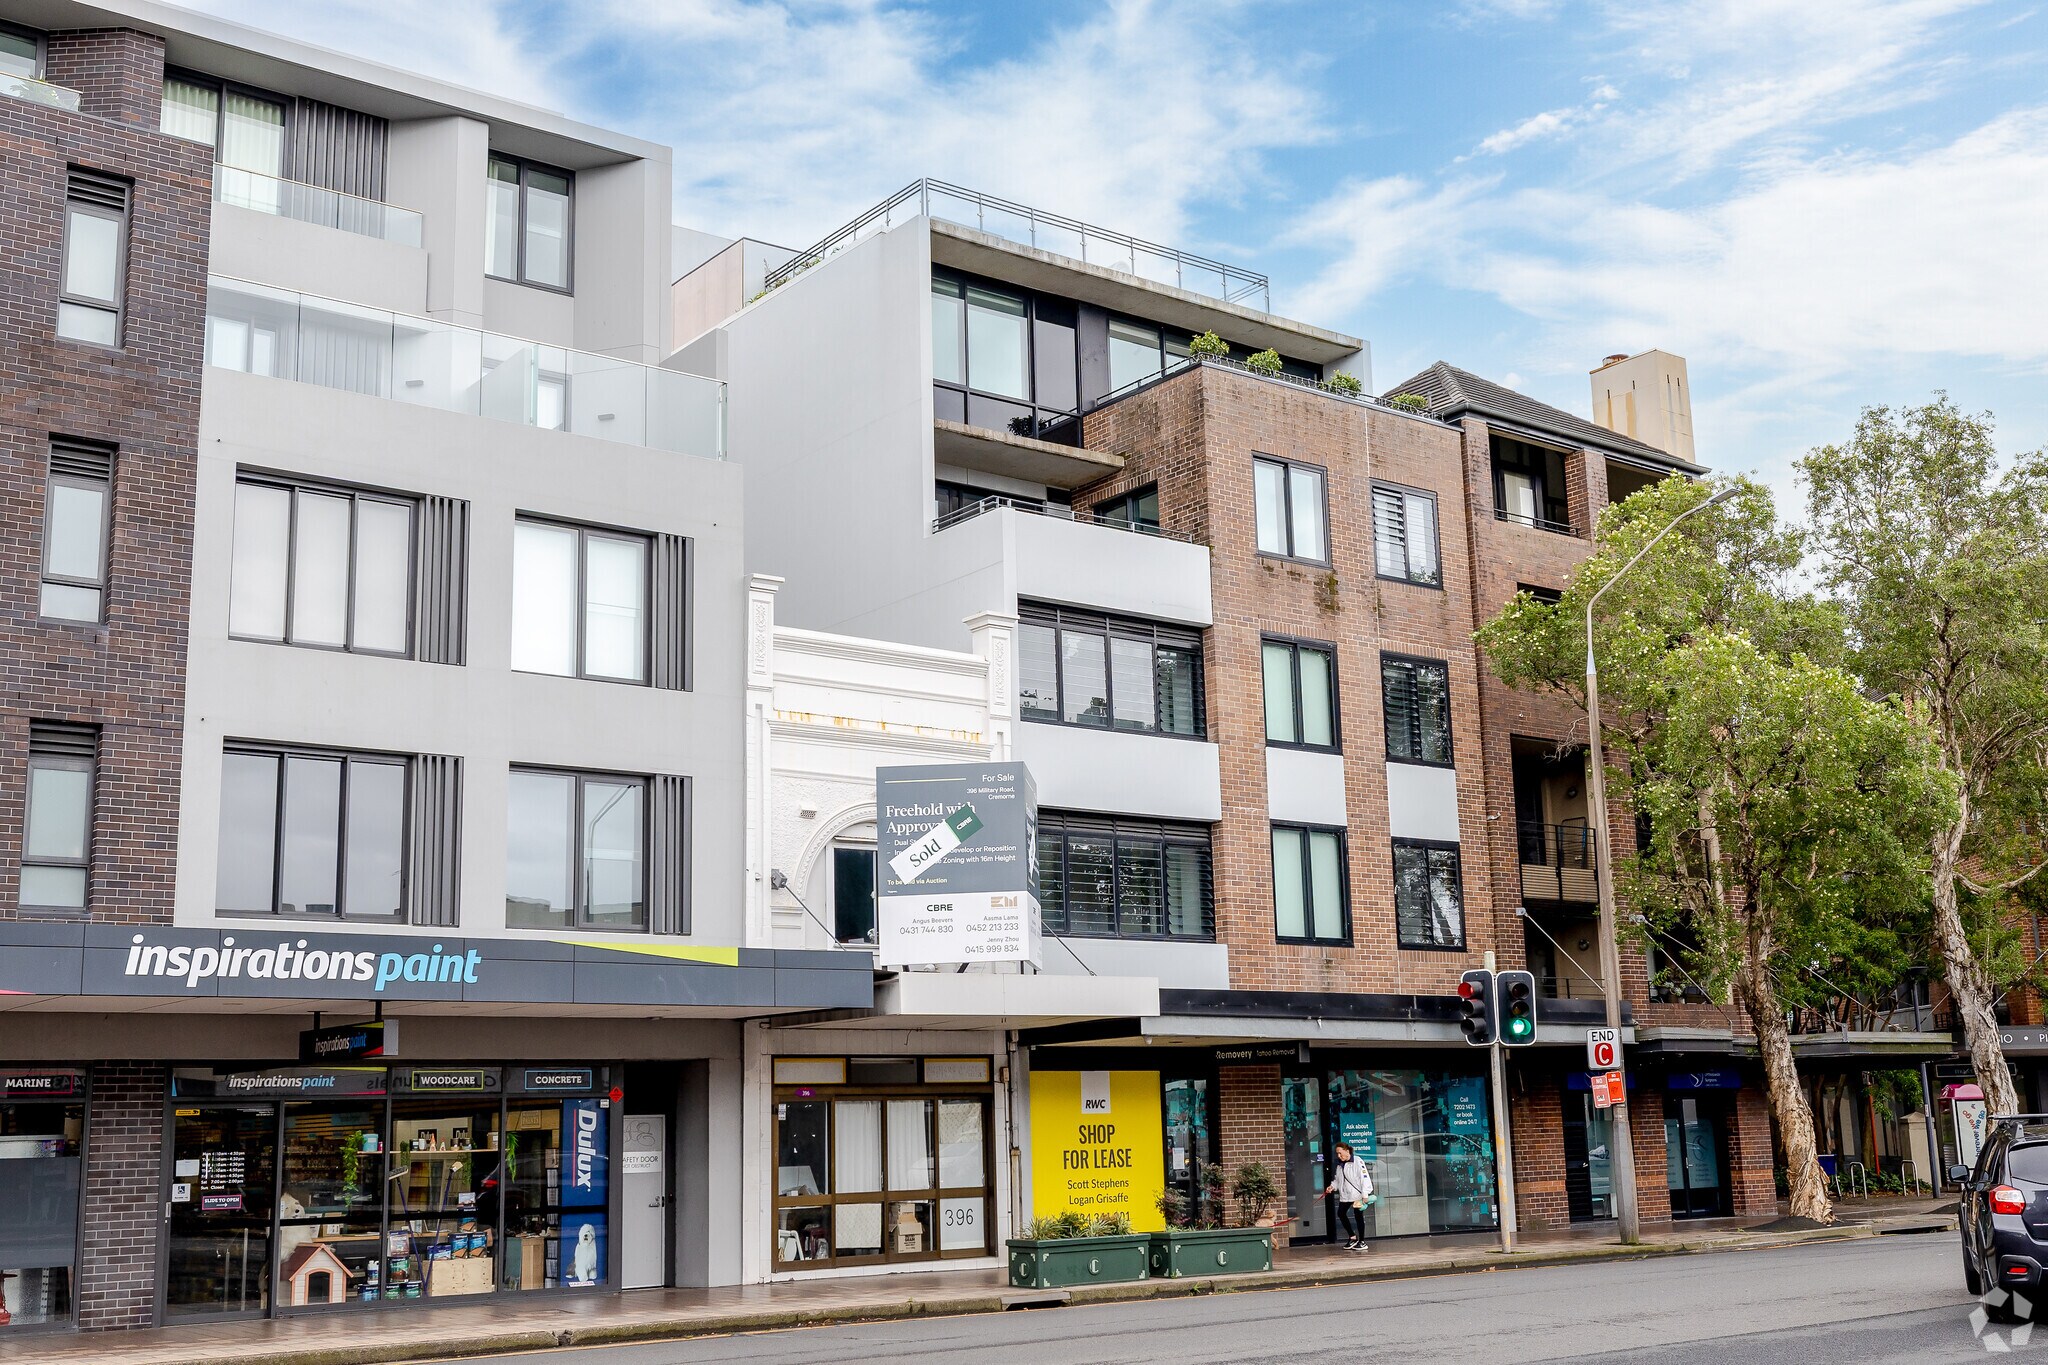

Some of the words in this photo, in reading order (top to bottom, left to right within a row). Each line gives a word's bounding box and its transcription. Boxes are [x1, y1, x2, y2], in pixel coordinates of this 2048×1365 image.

[982, 774, 995, 782] For
[997, 773, 1015, 781] Sale
[886, 803, 943, 817] Freehold
[894, 838, 909, 846] Dual
[984, 844, 1017, 852] Reposition
[909, 838, 942, 868] Sold
[943, 856, 964, 864] Zoning
[995, 854, 1016, 863] Height
[927, 903, 953, 911] CBRE
[900, 926, 919, 934] 0431
[921, 926, 936, 934] 744
[938, 925, 953, 933] 830
[966, 923, 987, 932] 0452
[989, 923, 1002, 931] 213
[1004, 923, 1019, 931] 233
[965, 945, 984, 953] 0415
[986, 945, 1001, 953] 999
[1004, 944, 1019, 952] 834
[1592, 1031, 1614, 1041] END
[1216, 1050, 1252, 1059] Removery
[1599, 1044, 1609, 1064] C
[5, 1078, 50, 1087] MARINE
[421, 1076, 475, 1085] WOODCARE
[535, 1075, 582, 1084] CONCRETE
[1085, 1099, 1105, 1108] RWC
[1079, 1124, 1115, 1144] SHOP
[577, 1108, 597, 1192] Dulux
[641, 1155, 658, 1163] DOOR
[1063, 1150, 1089, 1169] FOR
[1094, 1148, 1132, 1168] LEASE
[1068, 1179, 1089, 1189] Scott
[1092, 1178, 1129, 1190] Stephens
[1069, 1194, 1094, 1206] Logan
[1096, 1192, 1128, 1203] Grisaffe
[945, 1208, 974, 1226] 396
